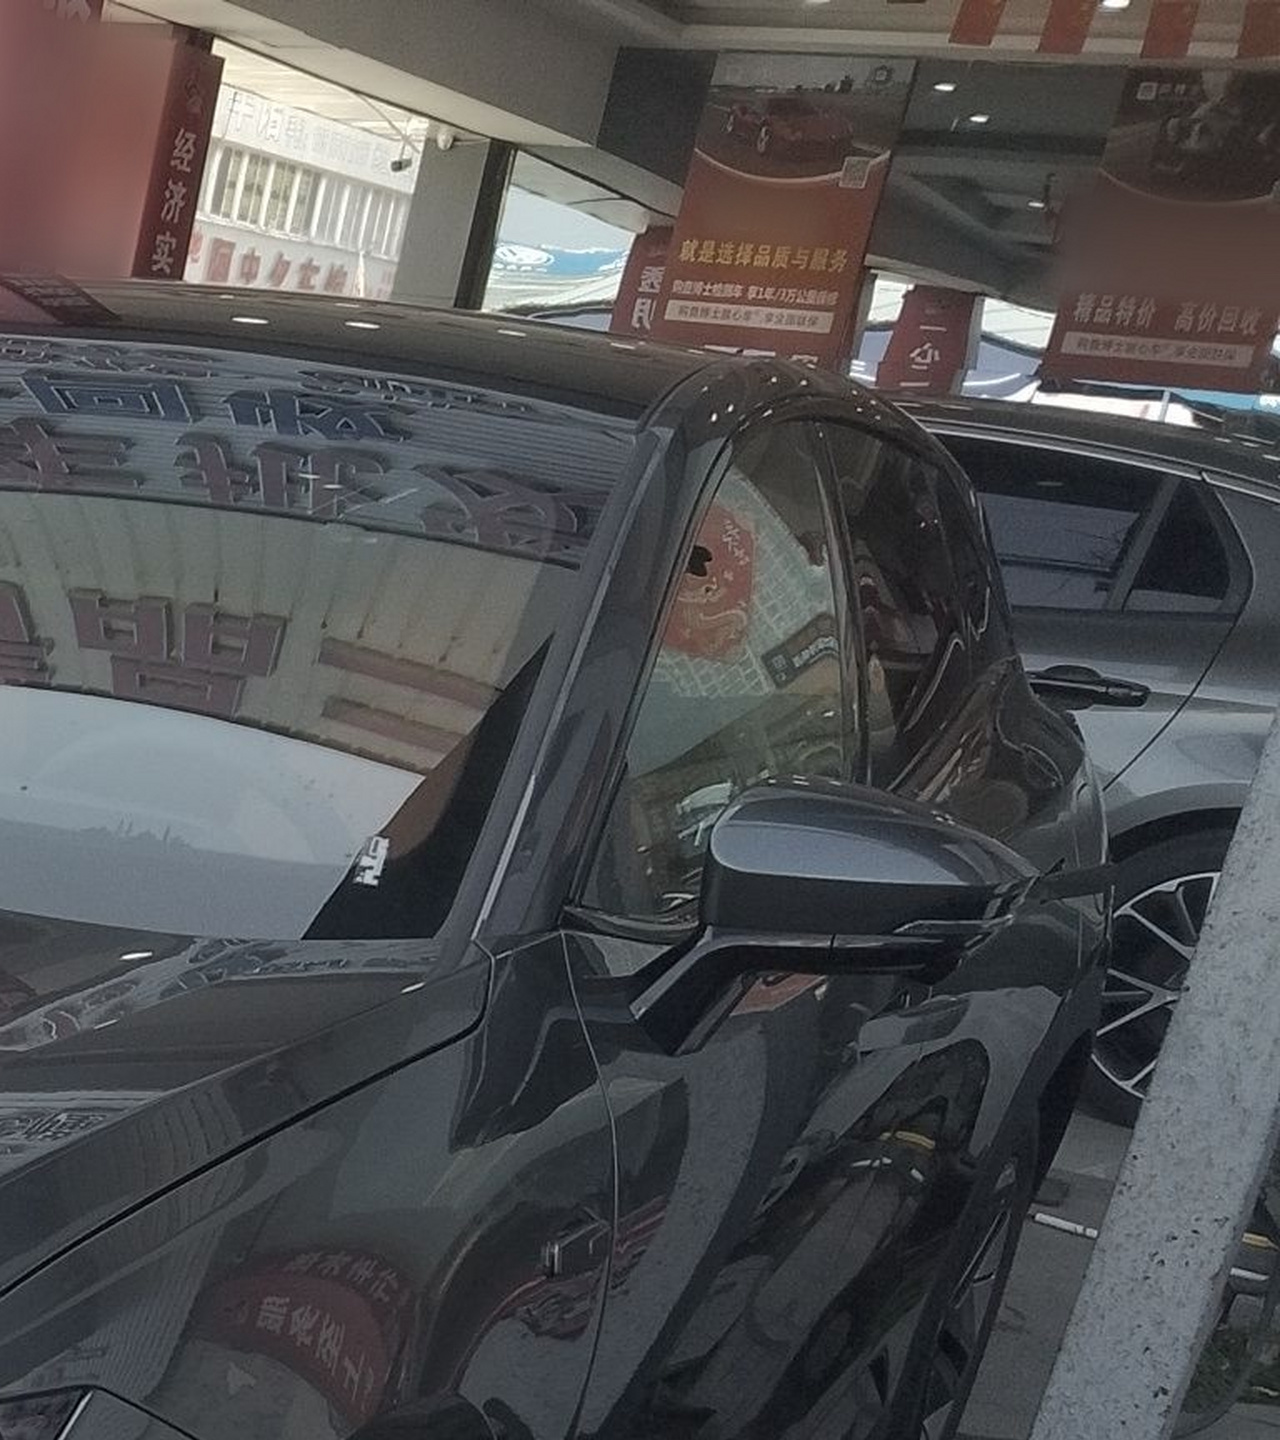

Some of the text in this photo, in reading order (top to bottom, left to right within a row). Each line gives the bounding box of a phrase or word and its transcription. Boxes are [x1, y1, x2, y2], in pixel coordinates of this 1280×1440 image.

[679, 240, 848, 272] 就是选择品质与服务
[1074, 293, 1263, 334] 精品特价 高价回收
